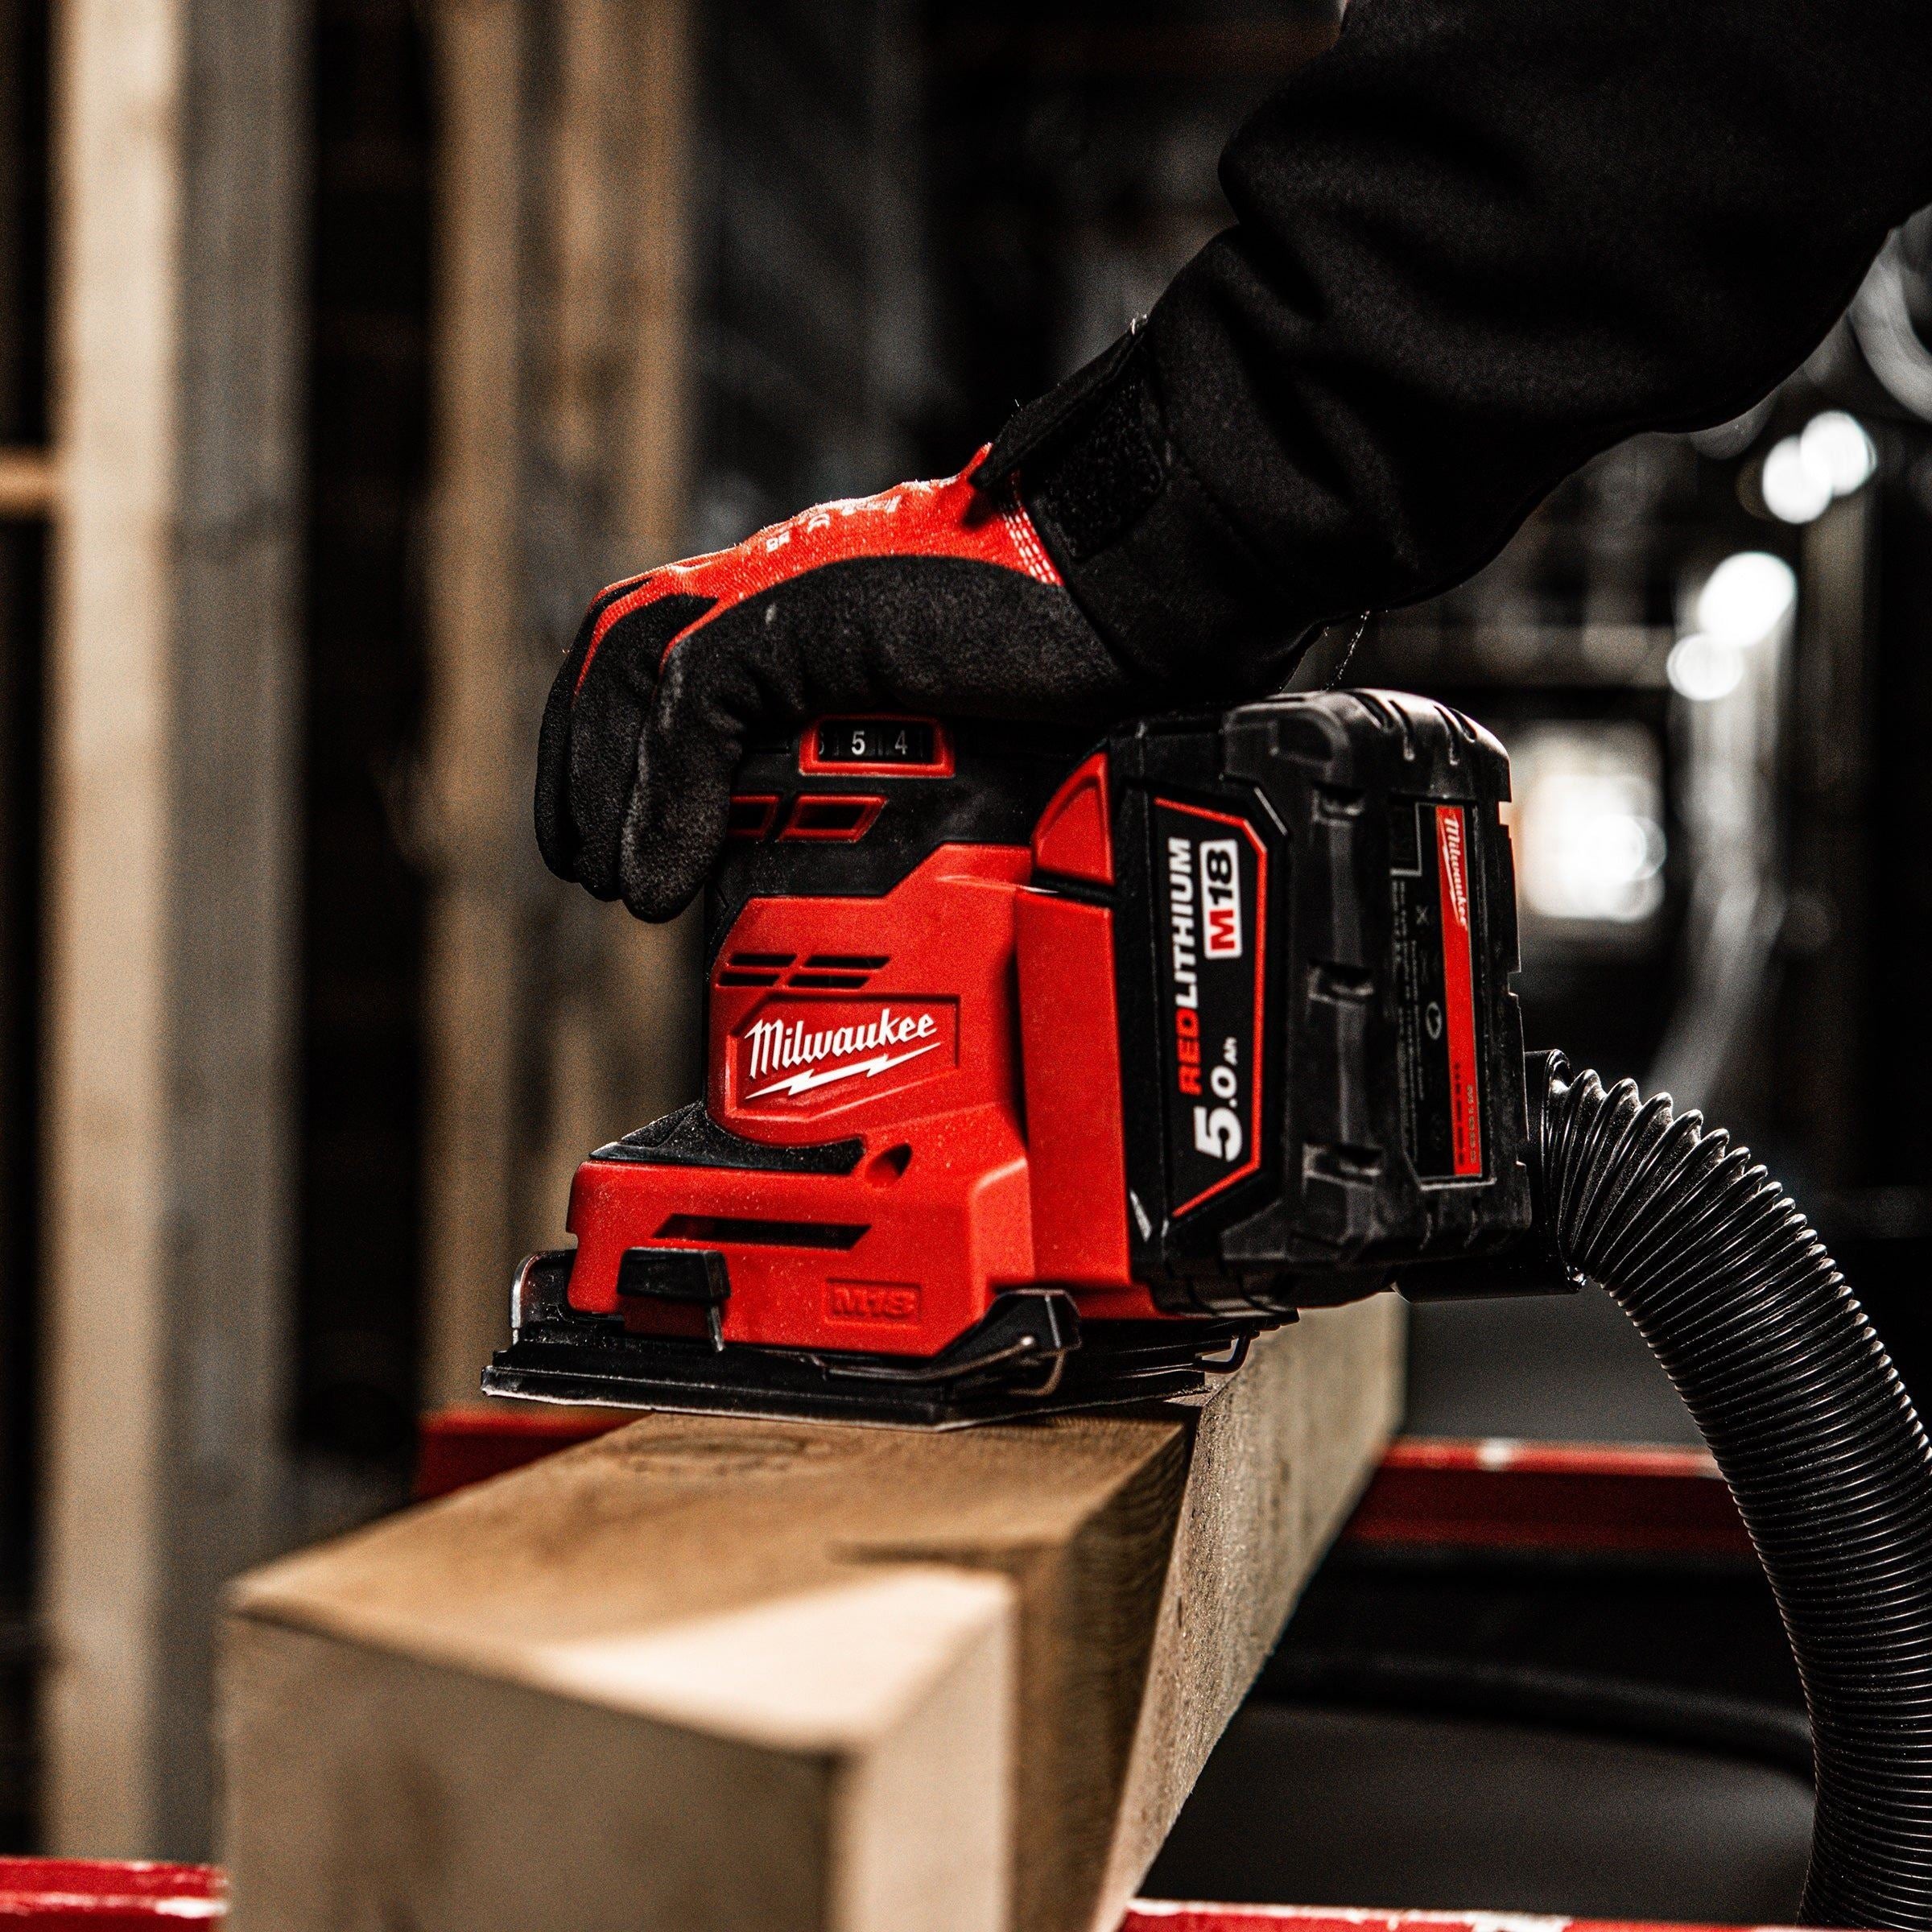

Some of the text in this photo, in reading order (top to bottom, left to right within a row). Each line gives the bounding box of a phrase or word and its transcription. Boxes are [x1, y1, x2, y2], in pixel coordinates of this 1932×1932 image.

[851, 730, 865, 755] 5
[894, 729, 908, 755] 4
[1208, 849, 1235, 951] M18
[1443, 813, 1468, 931] Milwaukee
[744, 1008, 938, 1080] Milwaukee
